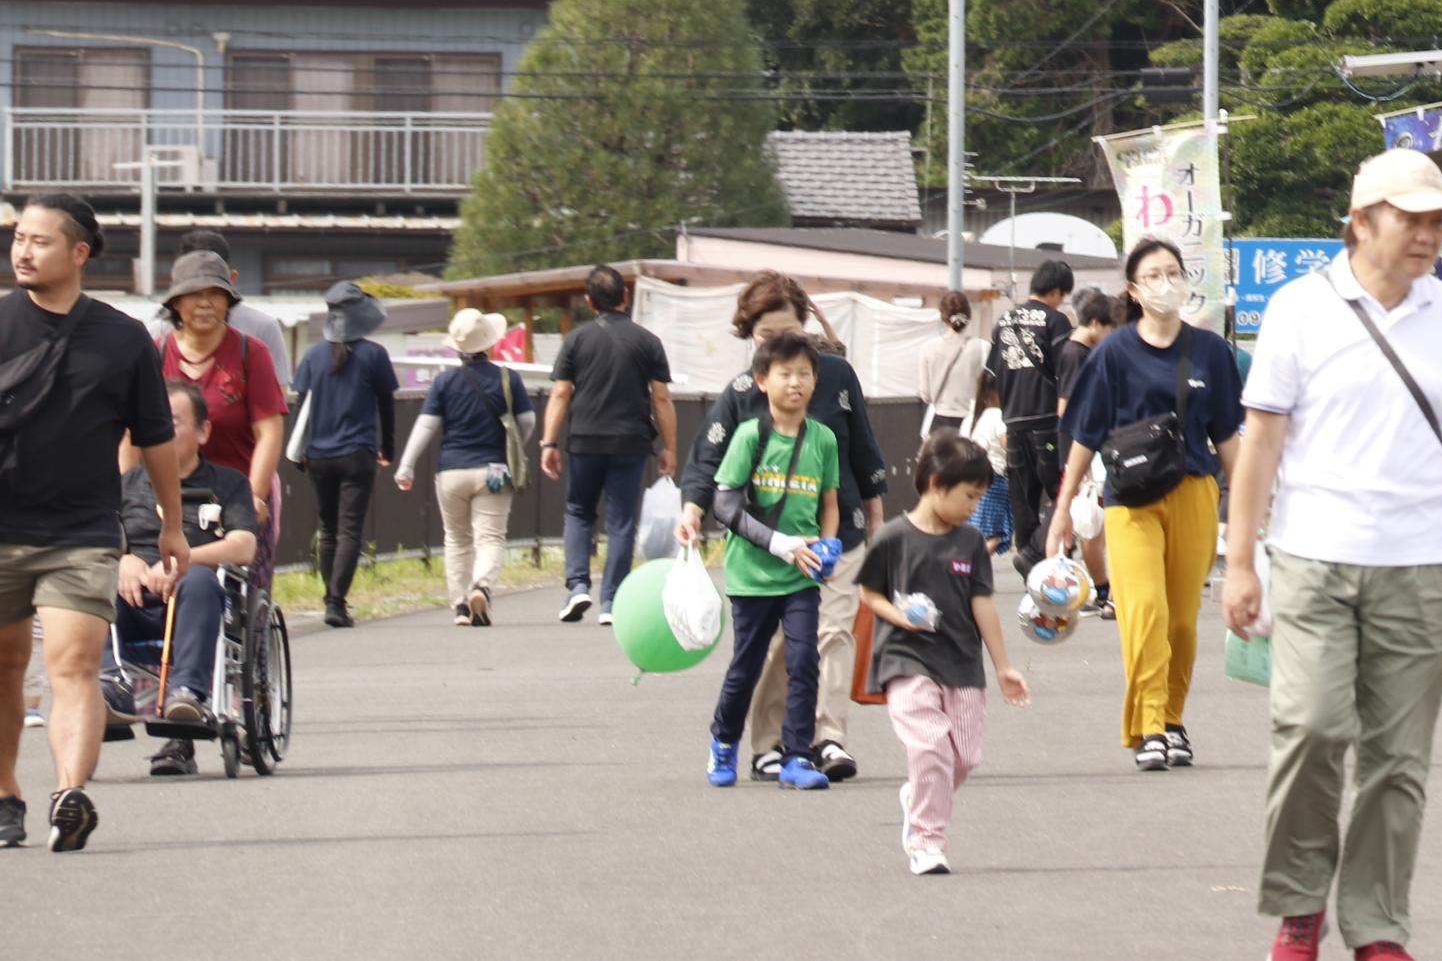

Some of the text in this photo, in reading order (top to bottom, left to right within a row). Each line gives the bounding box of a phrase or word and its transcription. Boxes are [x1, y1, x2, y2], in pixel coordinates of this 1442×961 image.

[1176, 162, 1207, 316] オーガニック
